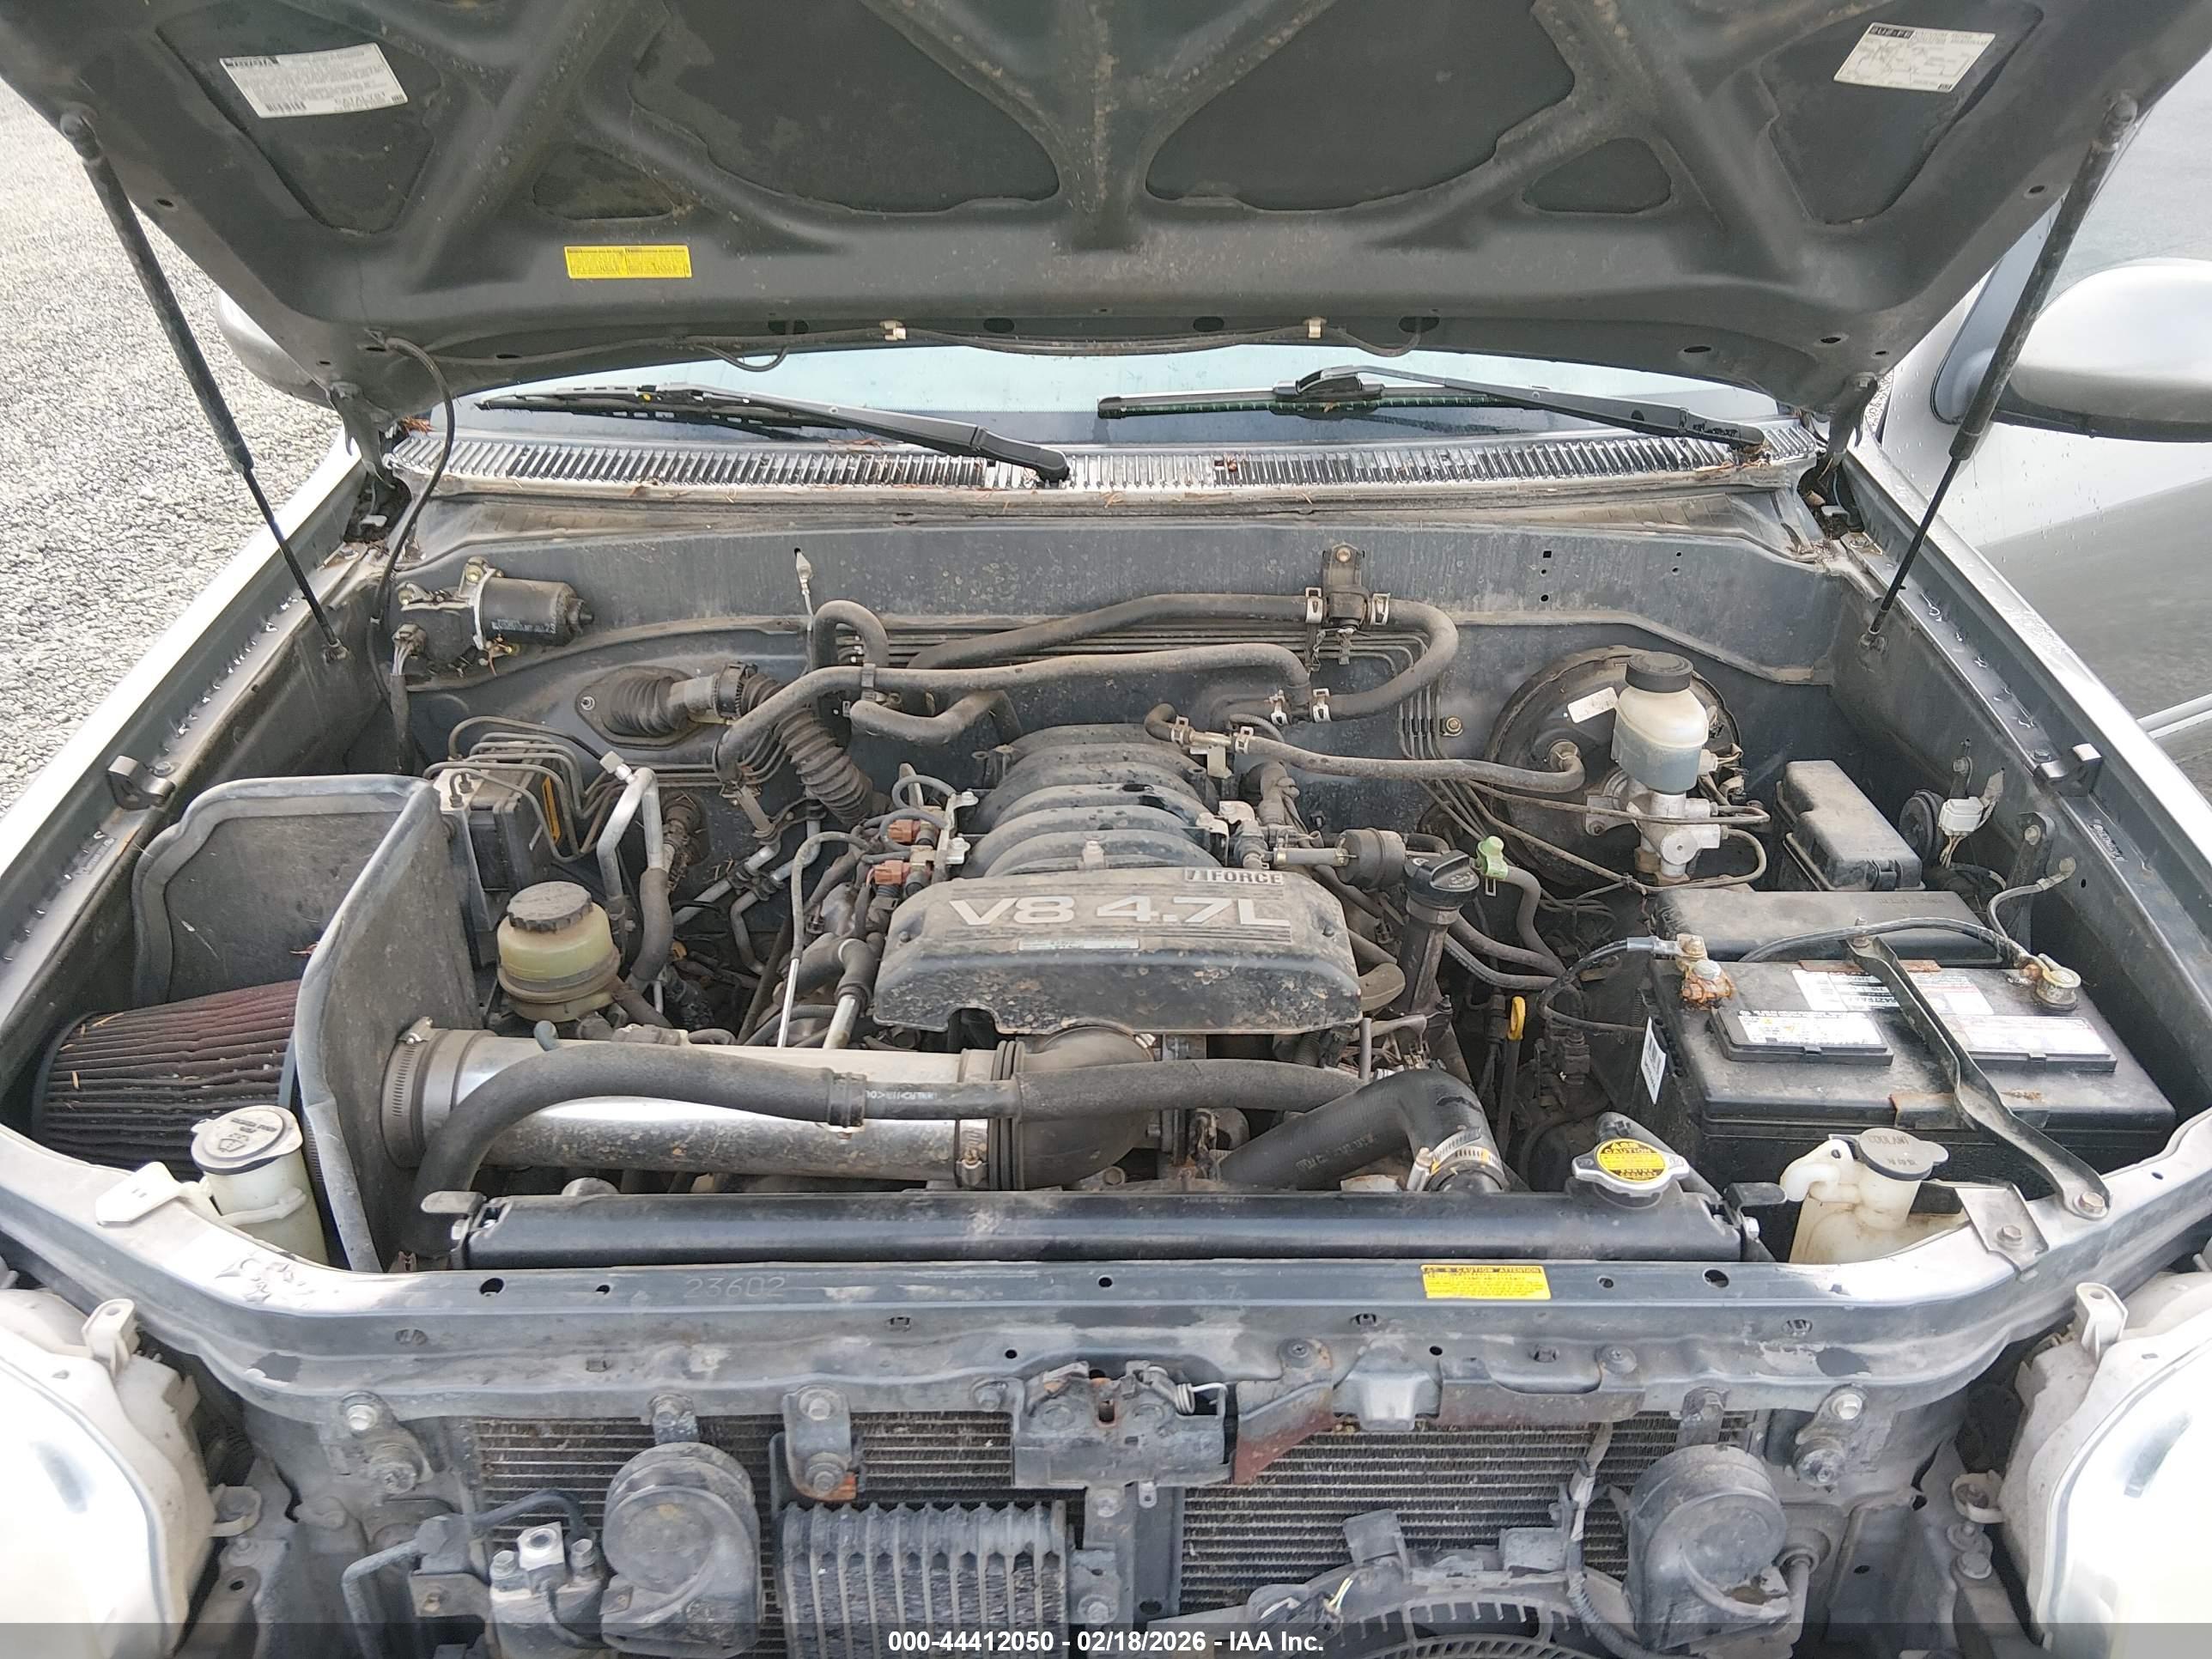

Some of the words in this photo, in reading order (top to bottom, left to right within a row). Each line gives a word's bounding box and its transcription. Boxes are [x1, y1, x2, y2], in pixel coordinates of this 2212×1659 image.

[949, 896, 1074, 926] V8
[1097, 896, 1290, 927] 4.7L
[1868, 1135, 1910, 1146] COOLANT
[684, 1276, 785, 1297] 23602
